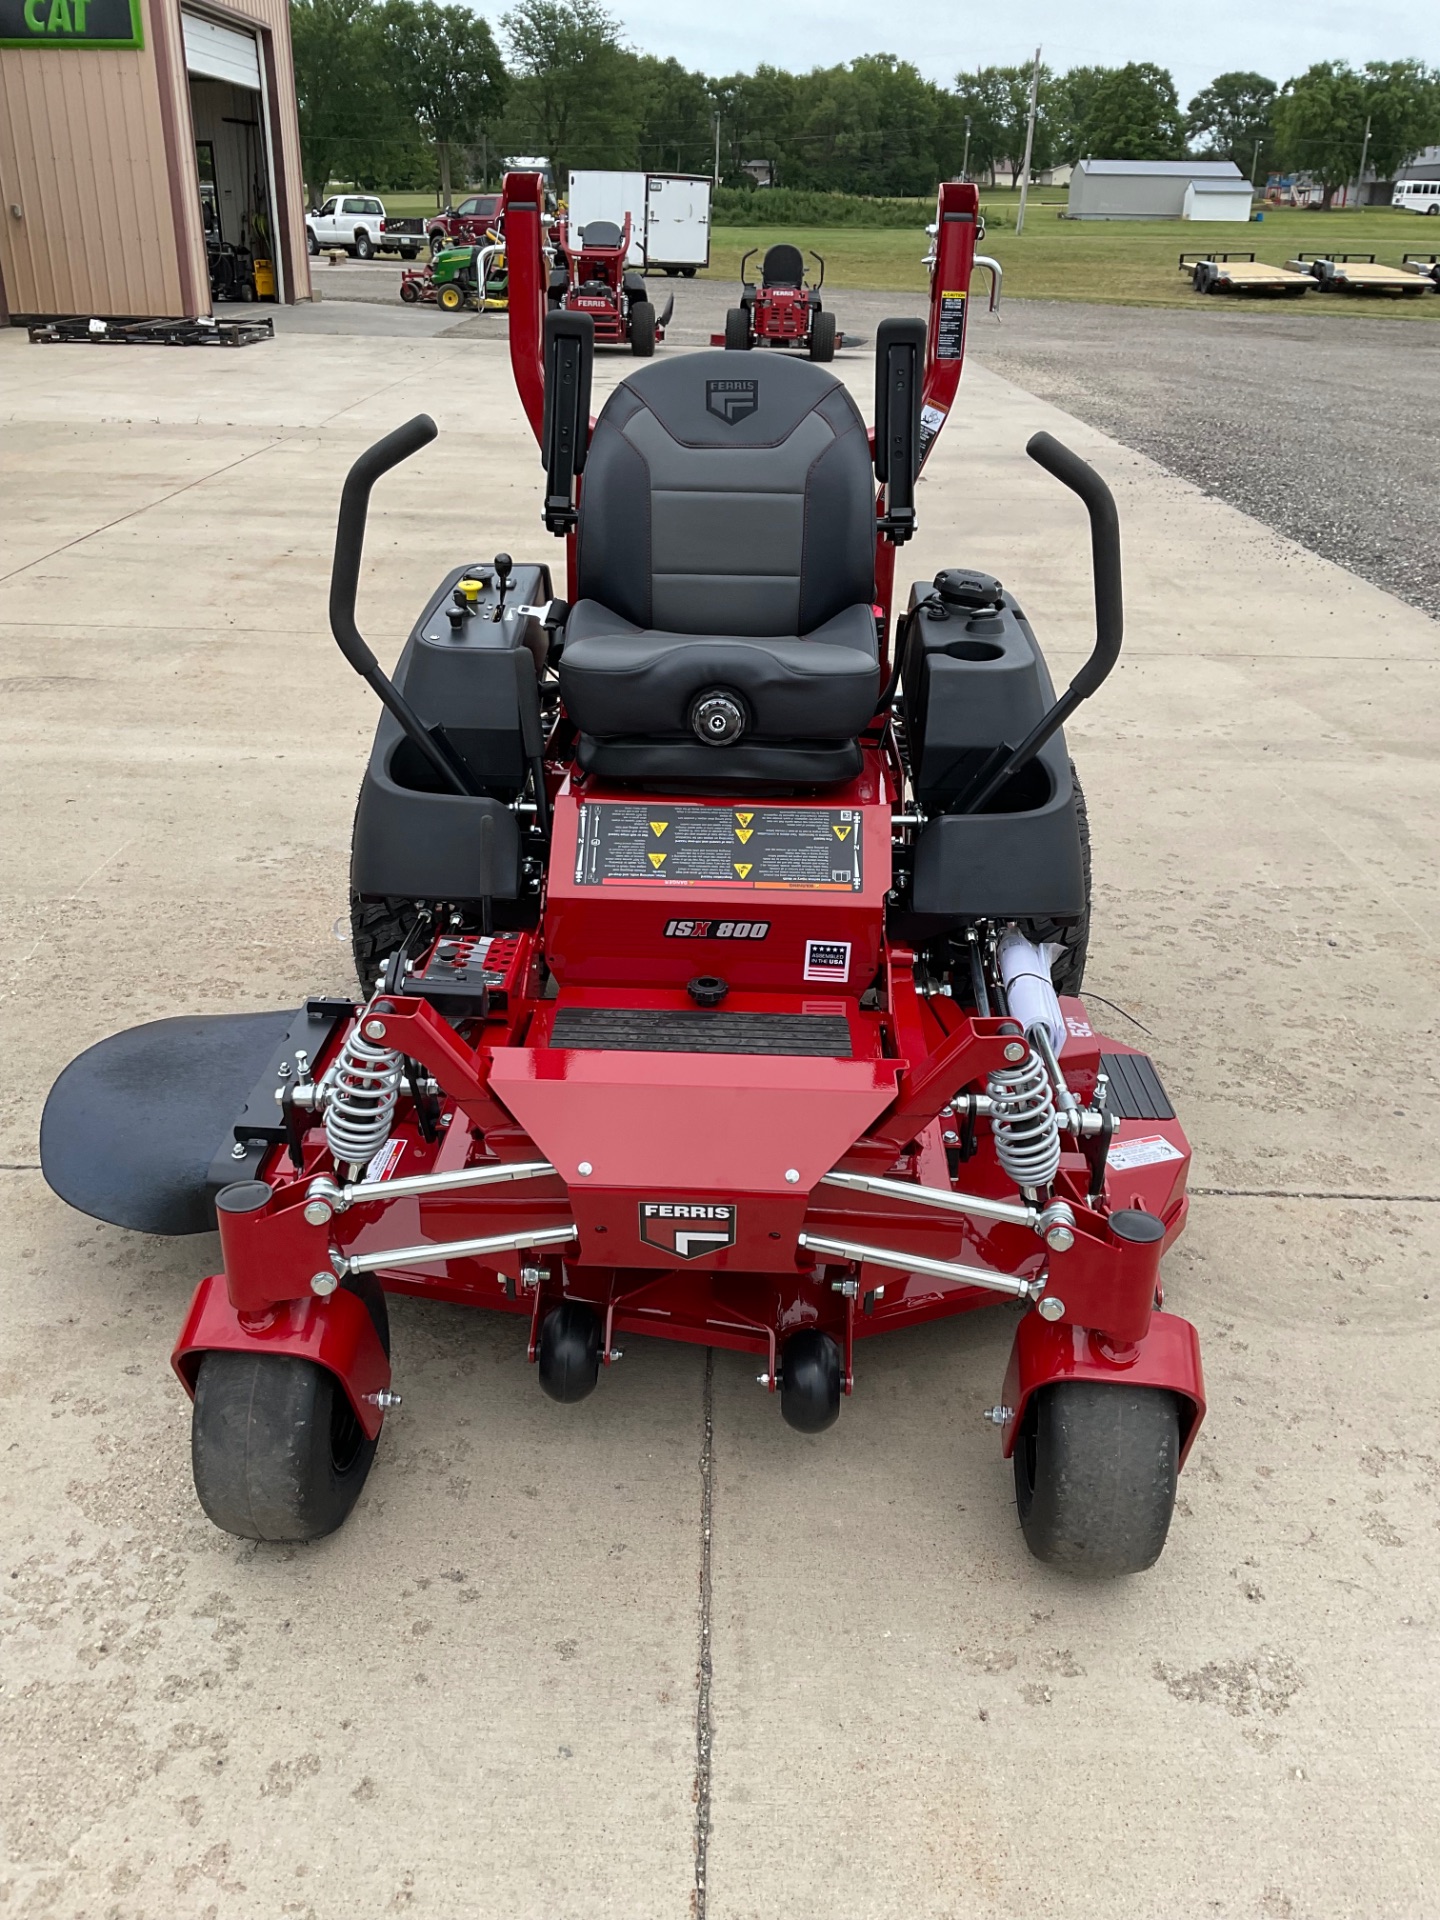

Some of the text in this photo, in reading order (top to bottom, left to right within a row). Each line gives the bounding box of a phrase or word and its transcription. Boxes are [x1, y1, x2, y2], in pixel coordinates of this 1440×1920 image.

[772, 289, 795, 297] FERRIS
[577, 299, 606, 308] FERRIS
[710, 381, 755, 391] FERRIS
[665, 920, 769, 938] ISX 800
[811, 952, 844, 960] ASSEMBLED
[1065, 1017, 1093, 1038] 52"
[644, 1204, 730, 1219] FERRIS
